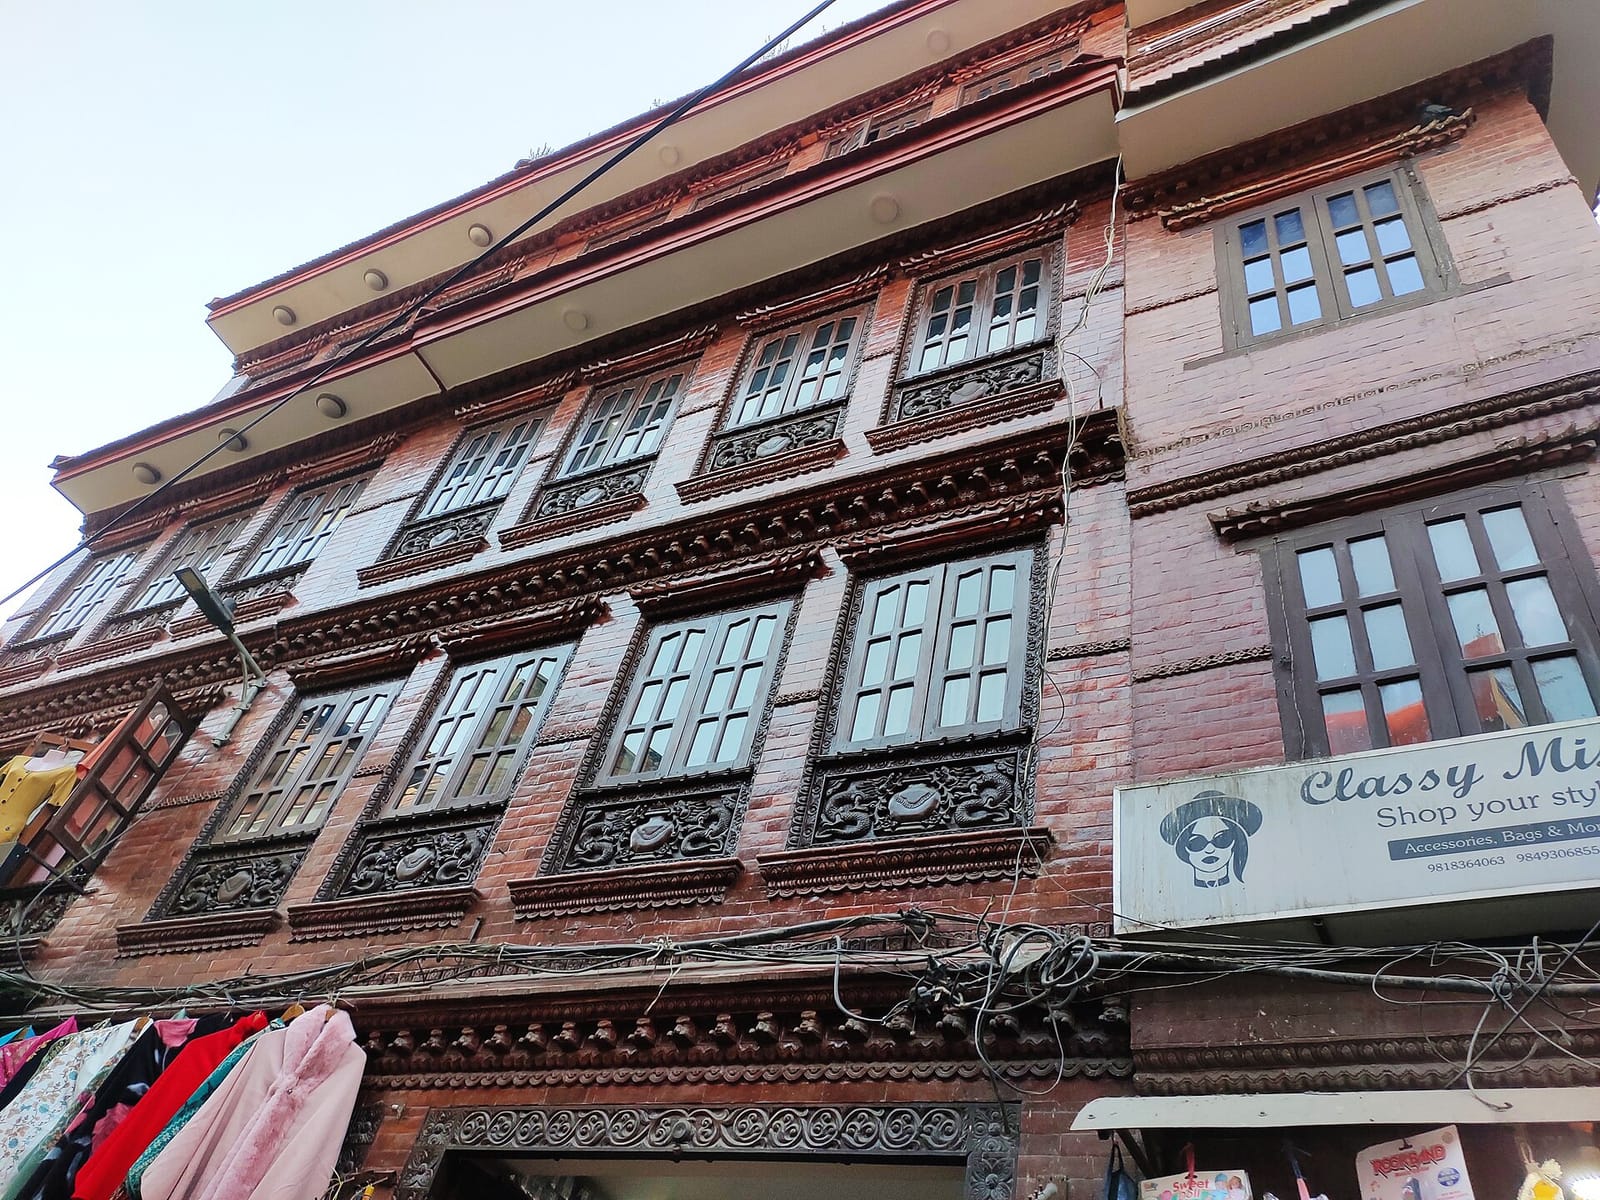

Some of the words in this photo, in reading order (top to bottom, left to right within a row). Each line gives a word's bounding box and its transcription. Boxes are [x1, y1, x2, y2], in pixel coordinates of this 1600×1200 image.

[1300, 763, 1484, 805] Classy
[1377, 804, 1457, 828] Shop
[1467, 794, 1540, 821] your
[1404, 836, 1498, 855] Accessories,
[1502, 829, 1543, 842] Bags
[1547, 825, 1564, 837] &
[1427, 855, 1506, 873] 9818364063
[1516, 845, 1600, 863] 9849306855
